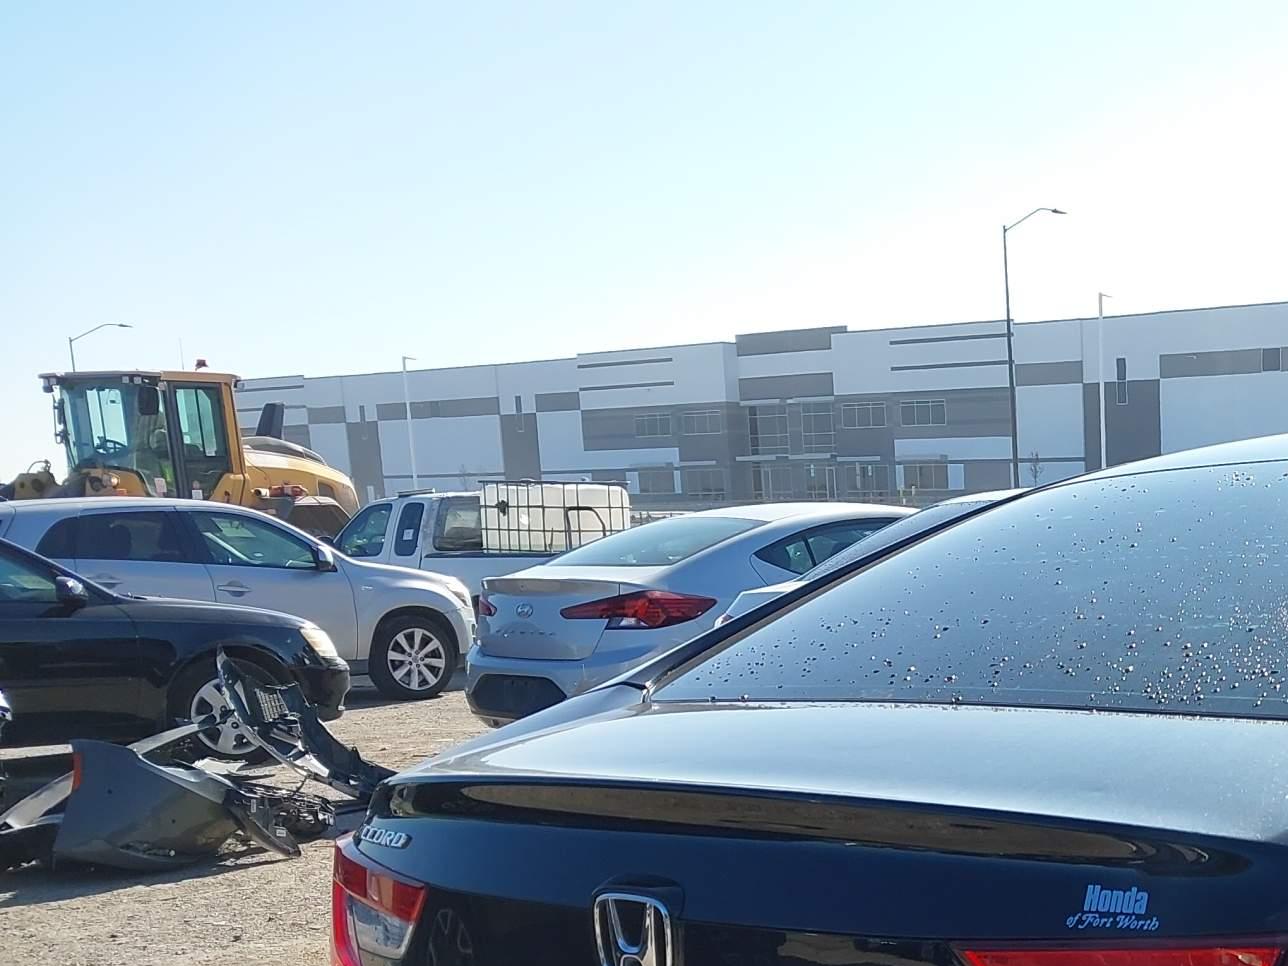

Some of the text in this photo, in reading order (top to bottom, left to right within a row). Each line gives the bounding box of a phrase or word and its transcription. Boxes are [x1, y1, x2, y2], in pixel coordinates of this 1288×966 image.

[361, 825, 409, 847] CCORD
[1083, 884, 1149, 915] Honda
[1066, 912, 1159, 931] of Fort Worth
